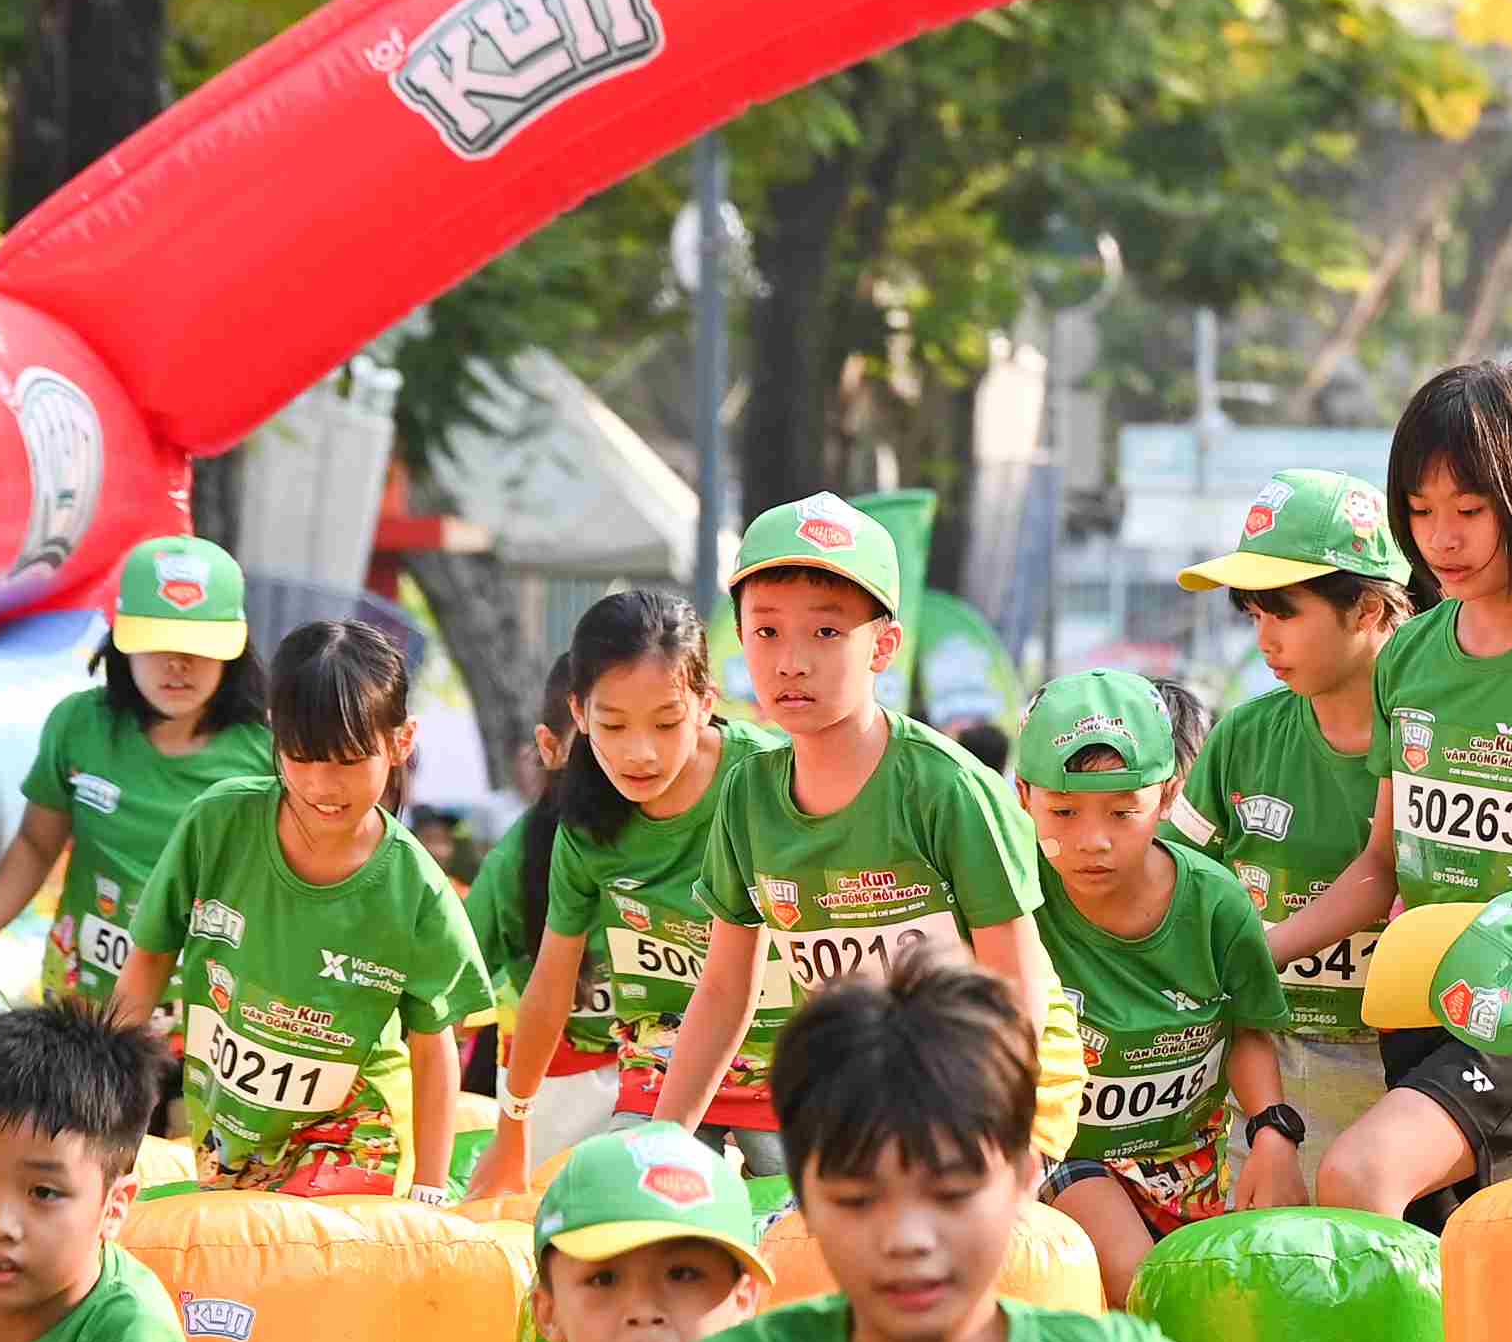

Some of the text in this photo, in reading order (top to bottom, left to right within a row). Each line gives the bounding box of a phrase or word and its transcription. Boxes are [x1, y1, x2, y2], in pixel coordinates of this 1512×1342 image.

[860, 870, 897, 889] Kun
[895, 883, 931, 900] NGÀY
[297, 1006, 335, 1026] Kun
[1153, 1033, 1182, 1047] Cùng
[209, 1022, 323, 1106] 50211
[1079, 1063, 1208, 1122] 50048
